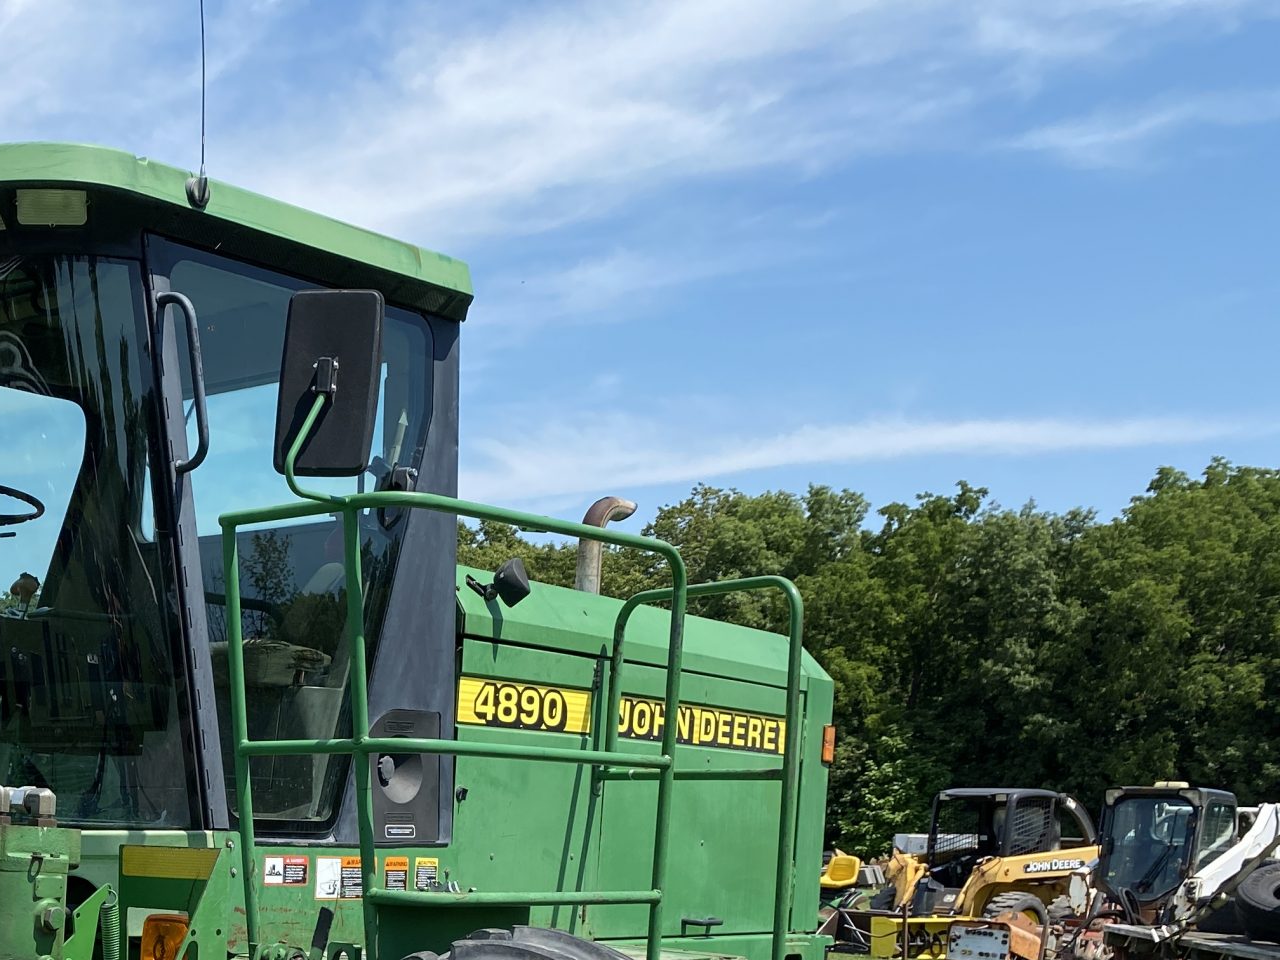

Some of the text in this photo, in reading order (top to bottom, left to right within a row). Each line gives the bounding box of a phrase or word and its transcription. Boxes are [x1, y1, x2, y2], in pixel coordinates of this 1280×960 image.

[473, 681, 568, 730] 4890
[699, 709, 781, 750] DEERE
[1026, 858, 1081, 872] JOHN DEERE
